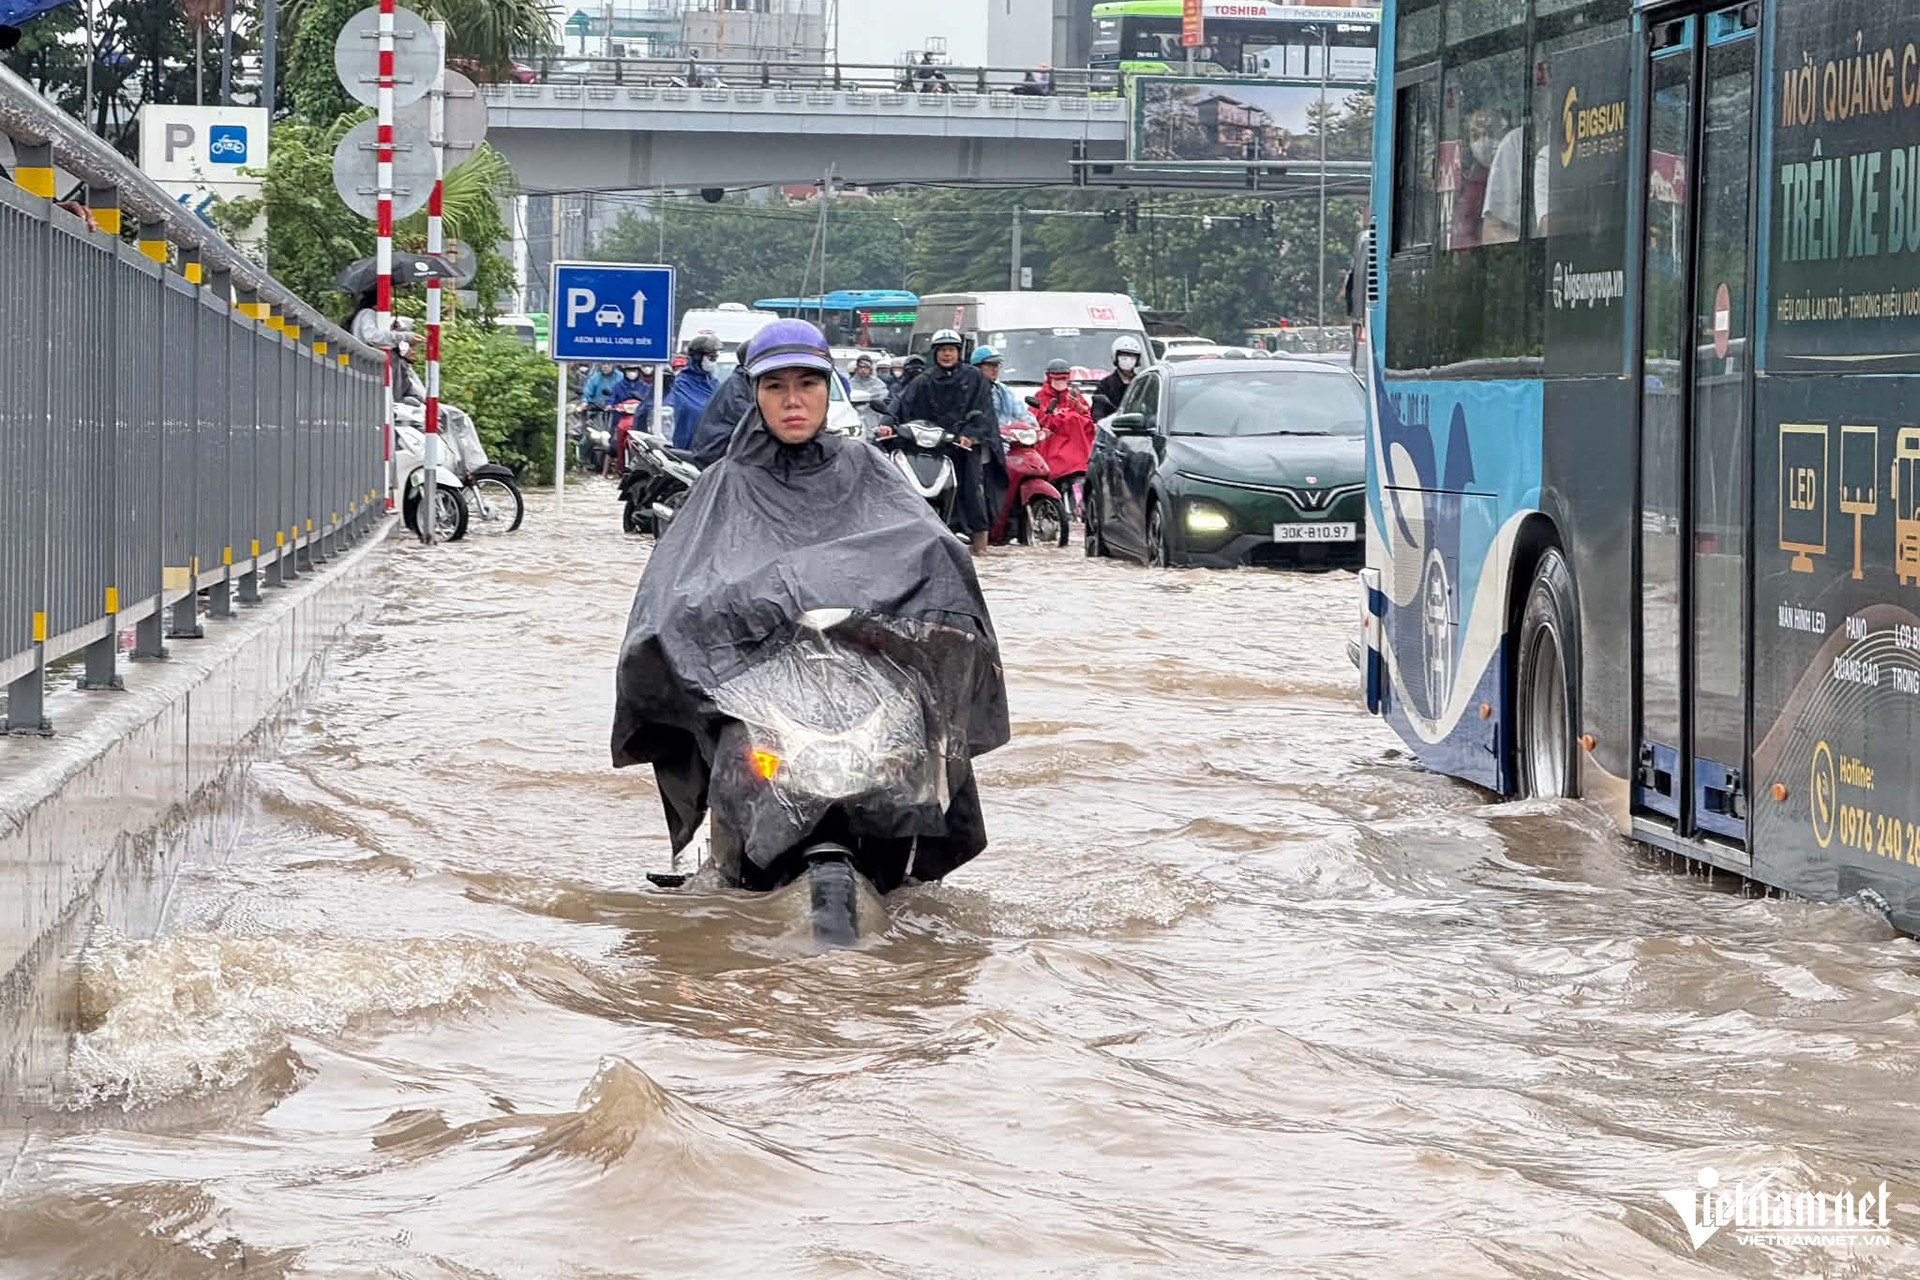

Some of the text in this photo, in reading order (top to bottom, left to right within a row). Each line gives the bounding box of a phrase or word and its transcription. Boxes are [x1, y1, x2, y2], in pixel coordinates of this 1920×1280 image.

[1215, 5, 1267, 16] TOSHIBA
[1783, 30, 1920, 127] MỜI QUẢNG C
[1578, 101, 1625, 139] BIGSUN
[165, 123, 195, 162] P
[1781, 138, 1841, 261] TRÊN
[1846, 151, 1881, 258] XE
[1564, 261, 1623, 309] bigsungroup.vn
[567, 288, 596, 328] P
[573, 336, 594, 344] AEON
[595, 336, 614, 345] MALL
[615, 337, 634, 345] LONG
[1789, 467, 1816, 510] LED
[1281, 526, 1349, 539] 30K-810.97
[1779, 600, 1826, 634] MÀN HÌNH LED
[1846, 616, 1867, 641] PANO
[1895, 623, 1911, 649] LCD
[1862, 657, 1880, 687] CÁO
[1891, 667, 1920, 695] TRONG
[1839, 754, 1875, 790] Hotline:
[1840, 804, 1873, 853] 0976
[1877, 814, 1902, 861] 240
